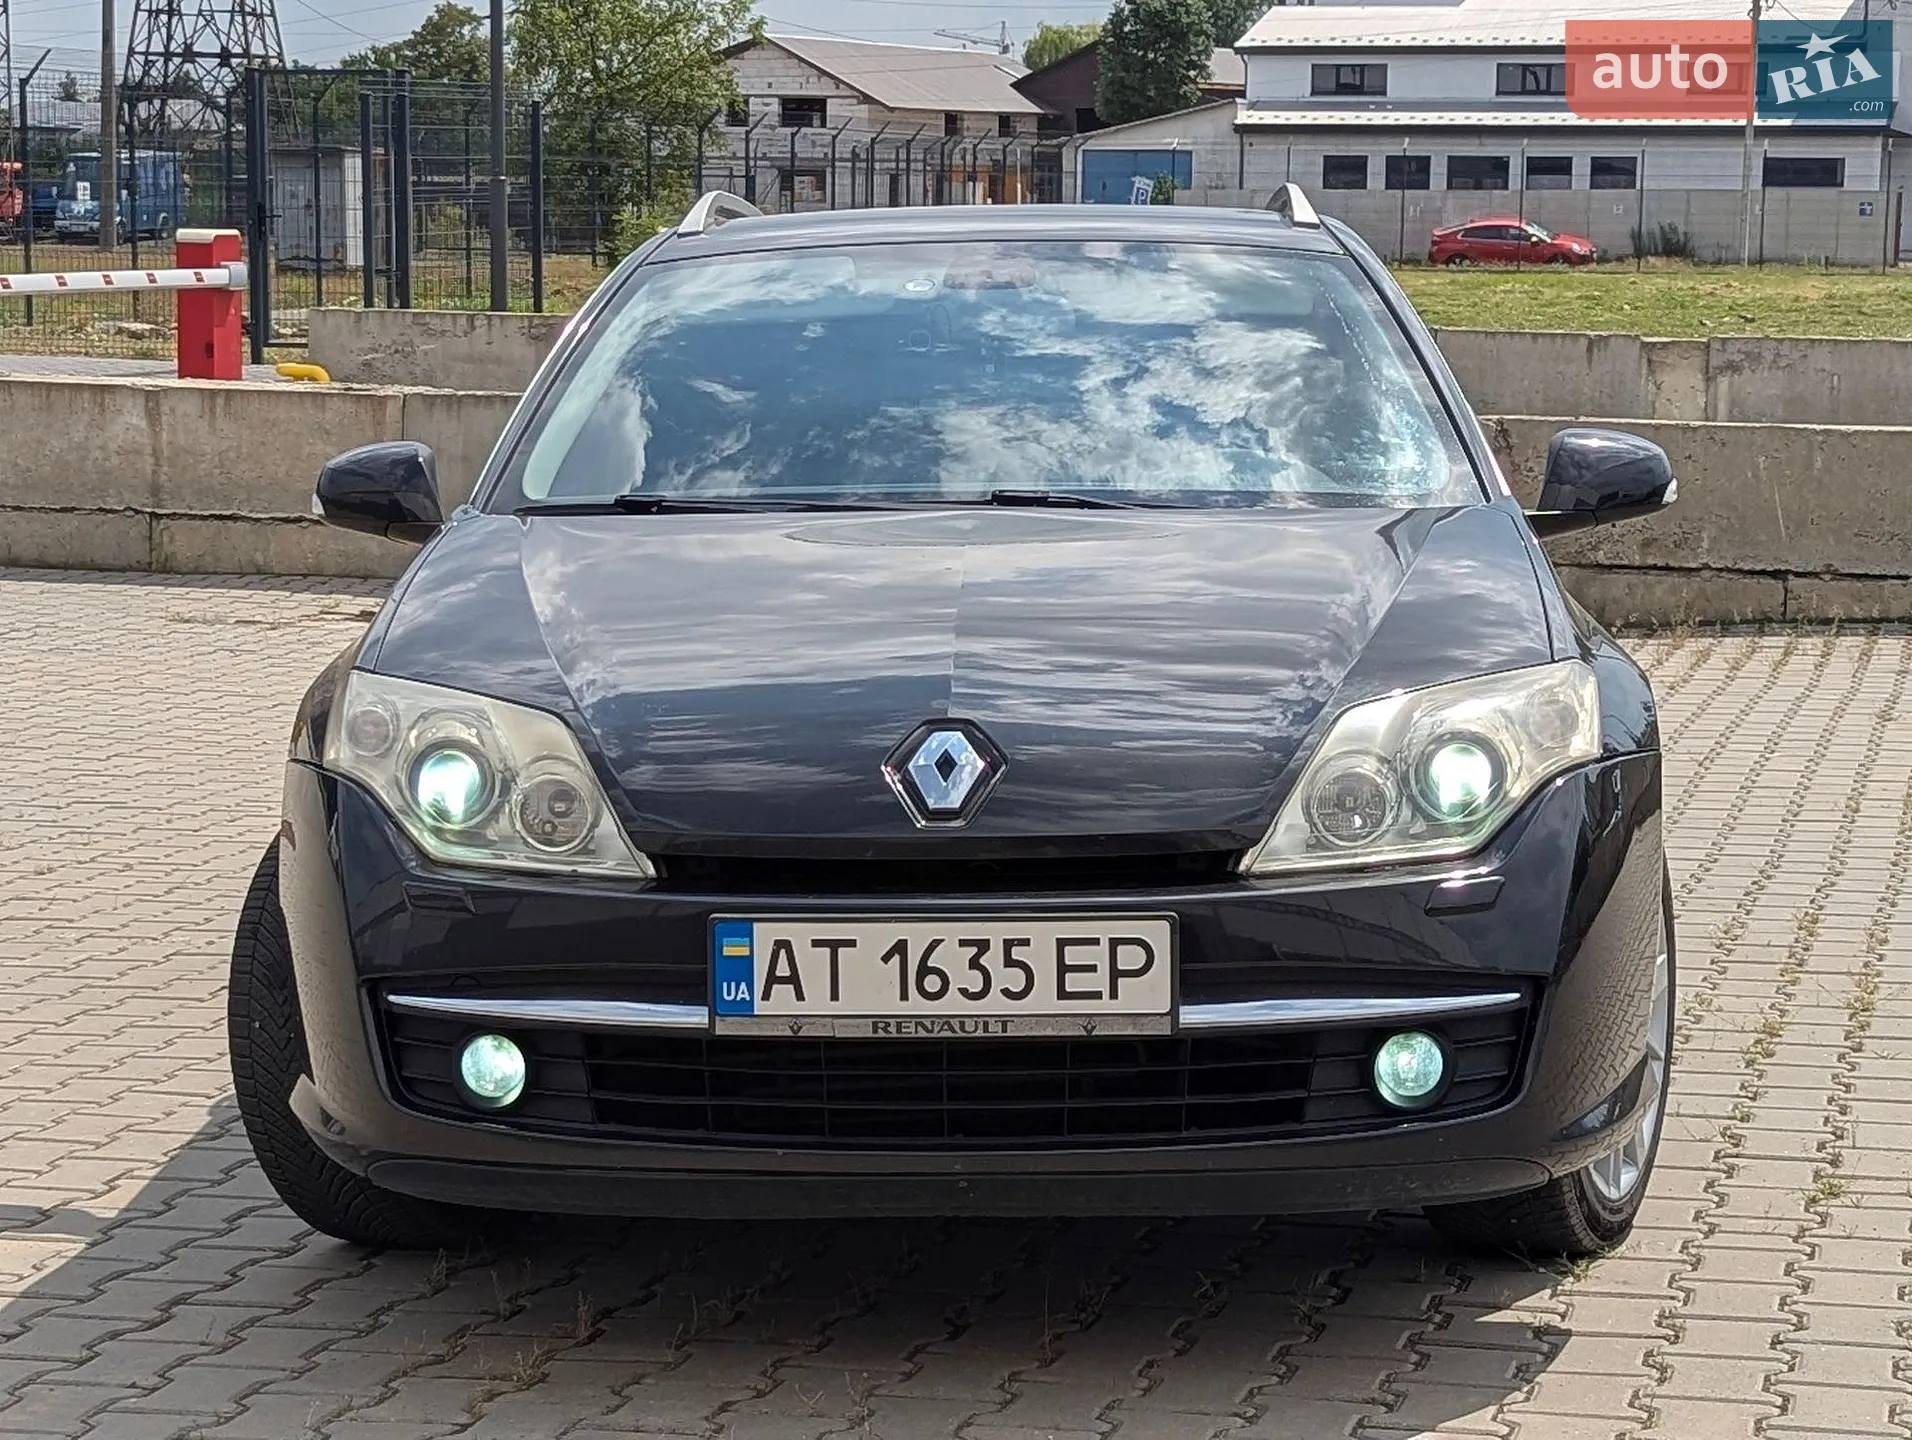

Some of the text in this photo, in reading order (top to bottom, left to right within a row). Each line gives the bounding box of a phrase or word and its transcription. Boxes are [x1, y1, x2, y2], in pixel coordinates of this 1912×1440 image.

[760, 937, 1155, 1001] AT 1635 EP
[722, 981, 750, 1001] UA
[871, 1019, 1014, 1035] RENAULT
